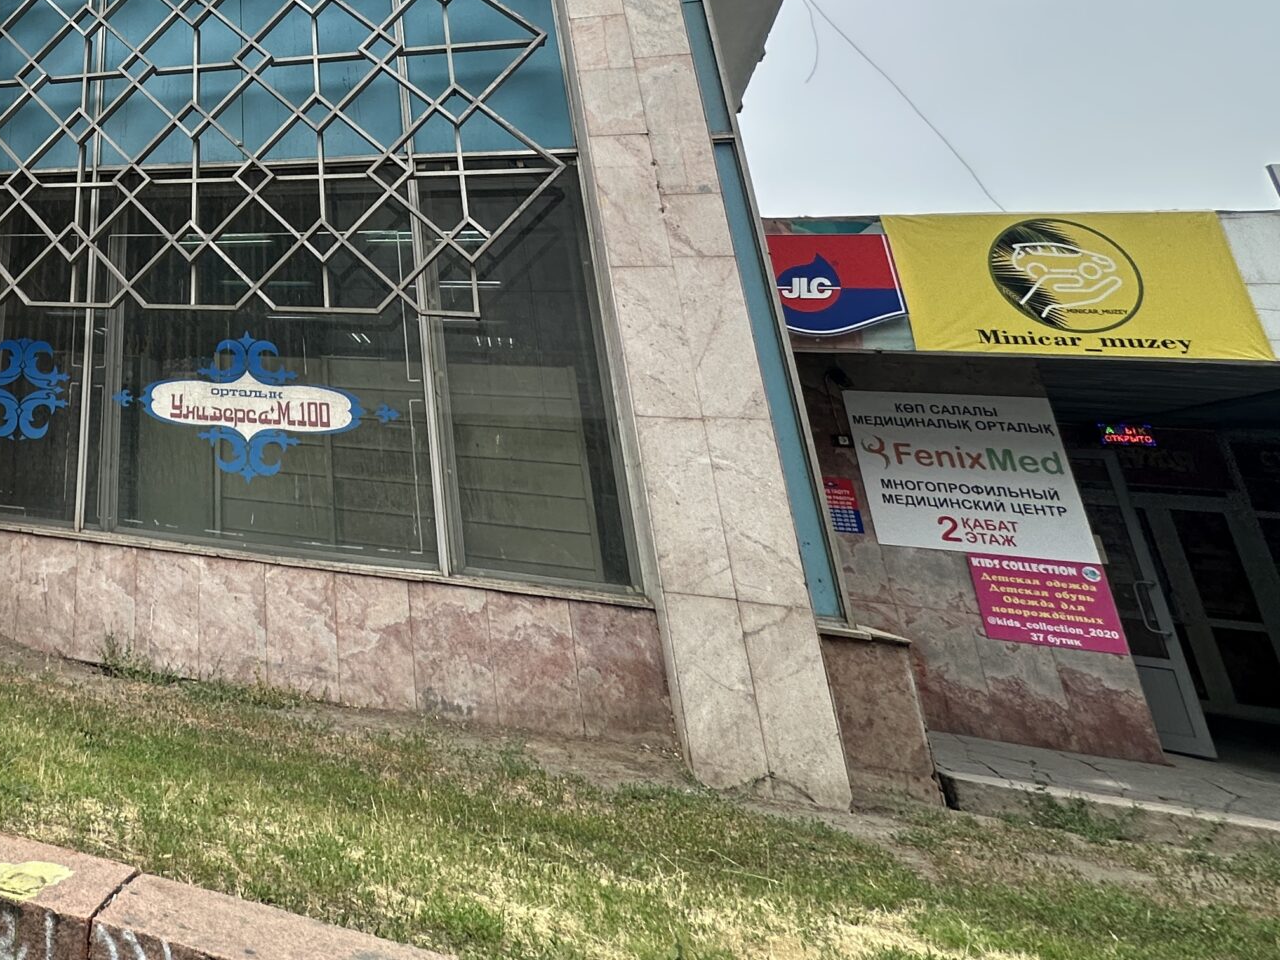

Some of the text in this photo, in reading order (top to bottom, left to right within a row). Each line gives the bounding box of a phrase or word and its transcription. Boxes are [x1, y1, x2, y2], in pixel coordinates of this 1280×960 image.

[894, 402, 998, 417] КӨП САЛАЛЫ
[852, 414, 1056, 437] МЕДИЦИНАЛЫҚ ОРТАЛЫҚ
[893, 442, 1065, 475] FenixMed
[880, 478, 1061, 501] МНОГОПРОФИЛЬНЫЙ
[882, 493, 1068, 517] МЕДИЦИНСКИЙ ЦЕНТР
[937, 515, 1019, 543] 2 ҚАБАТ
[966, 531, 1018, 547] ЭТАЖ
[971, 557, 1078, 576] KIDS COLLECTION
[980, 572, 1097, 592] Детская одежда
[989, 583, 1050, 597] Детская
[1003, 595, 1055, 609] Одежда
[1030, 632, 1082, 647] 37 бутик
